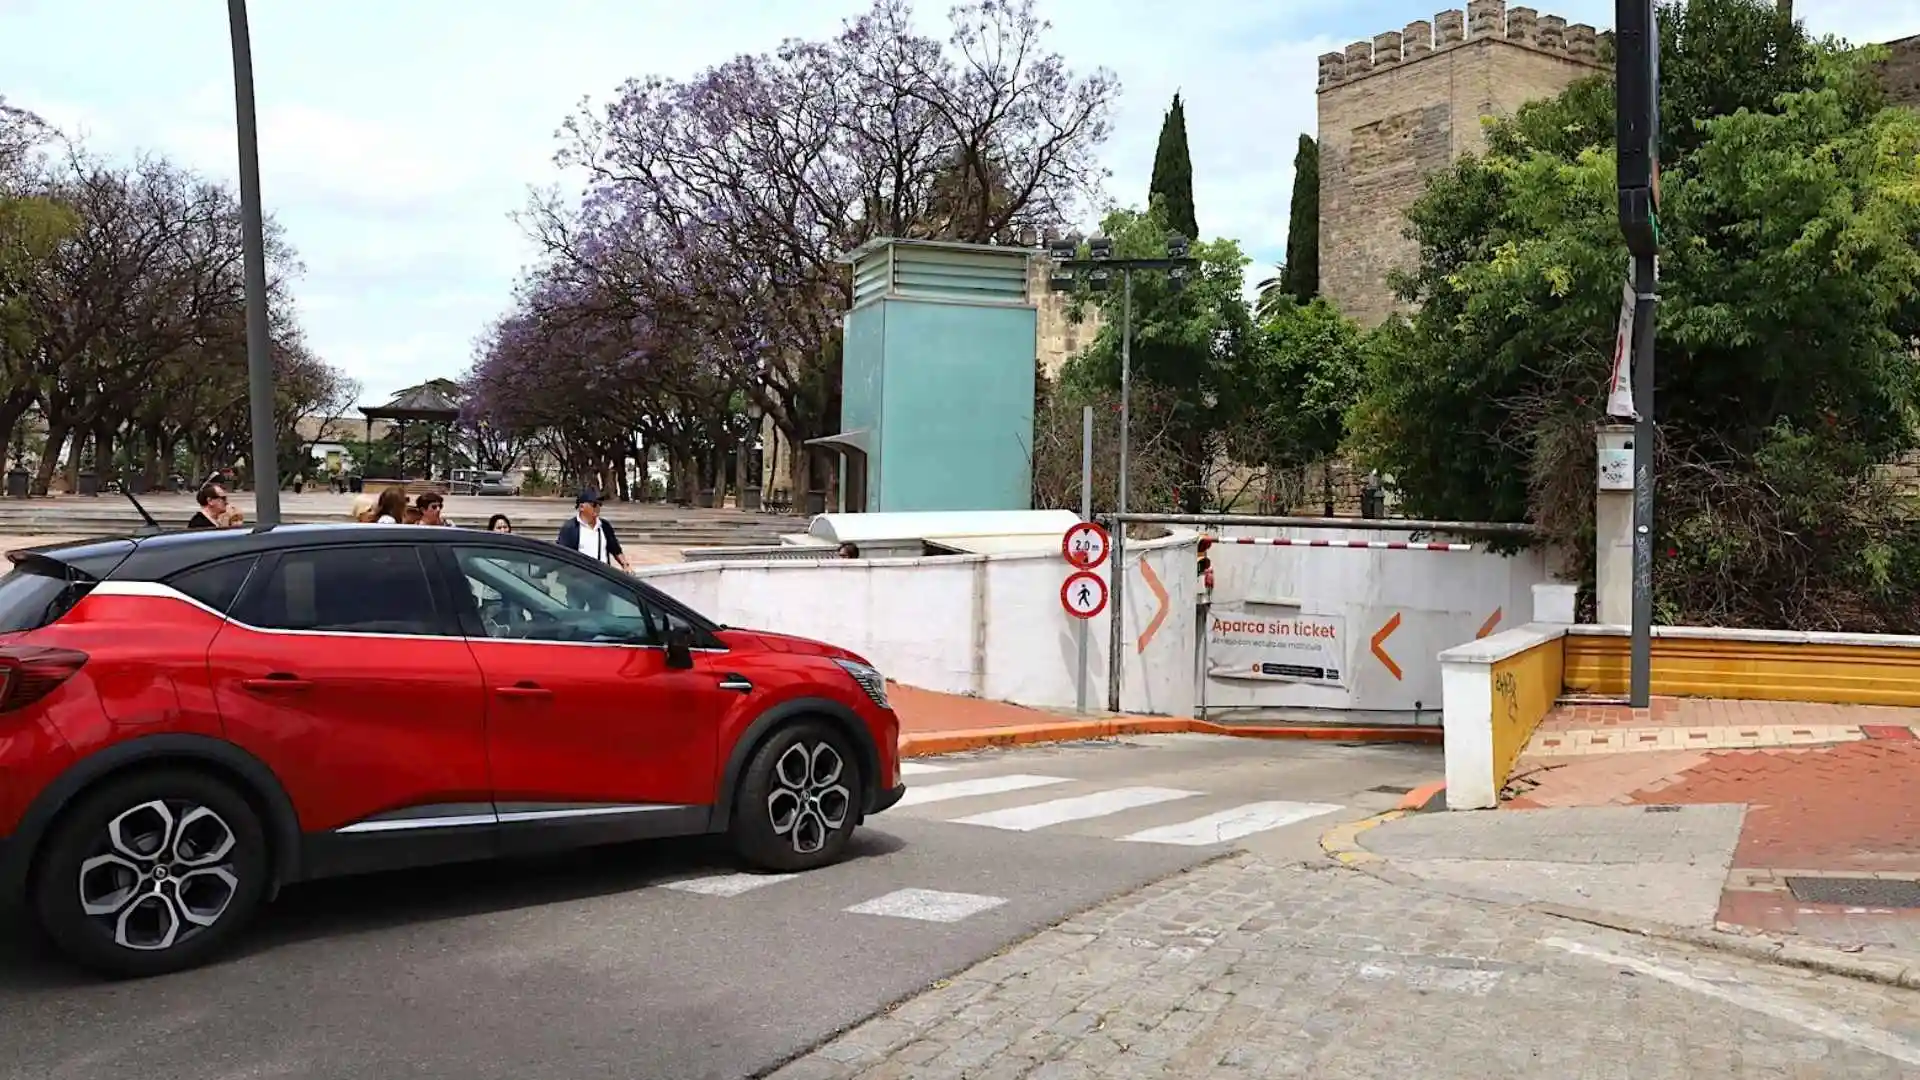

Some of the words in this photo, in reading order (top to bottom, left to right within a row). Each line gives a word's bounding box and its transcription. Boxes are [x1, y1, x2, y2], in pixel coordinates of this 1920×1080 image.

[1212, 619, 1265, 636] Aparca
[1268, 620, 1290, 635] sin
[1293, 622, 1336, 638] ticket
